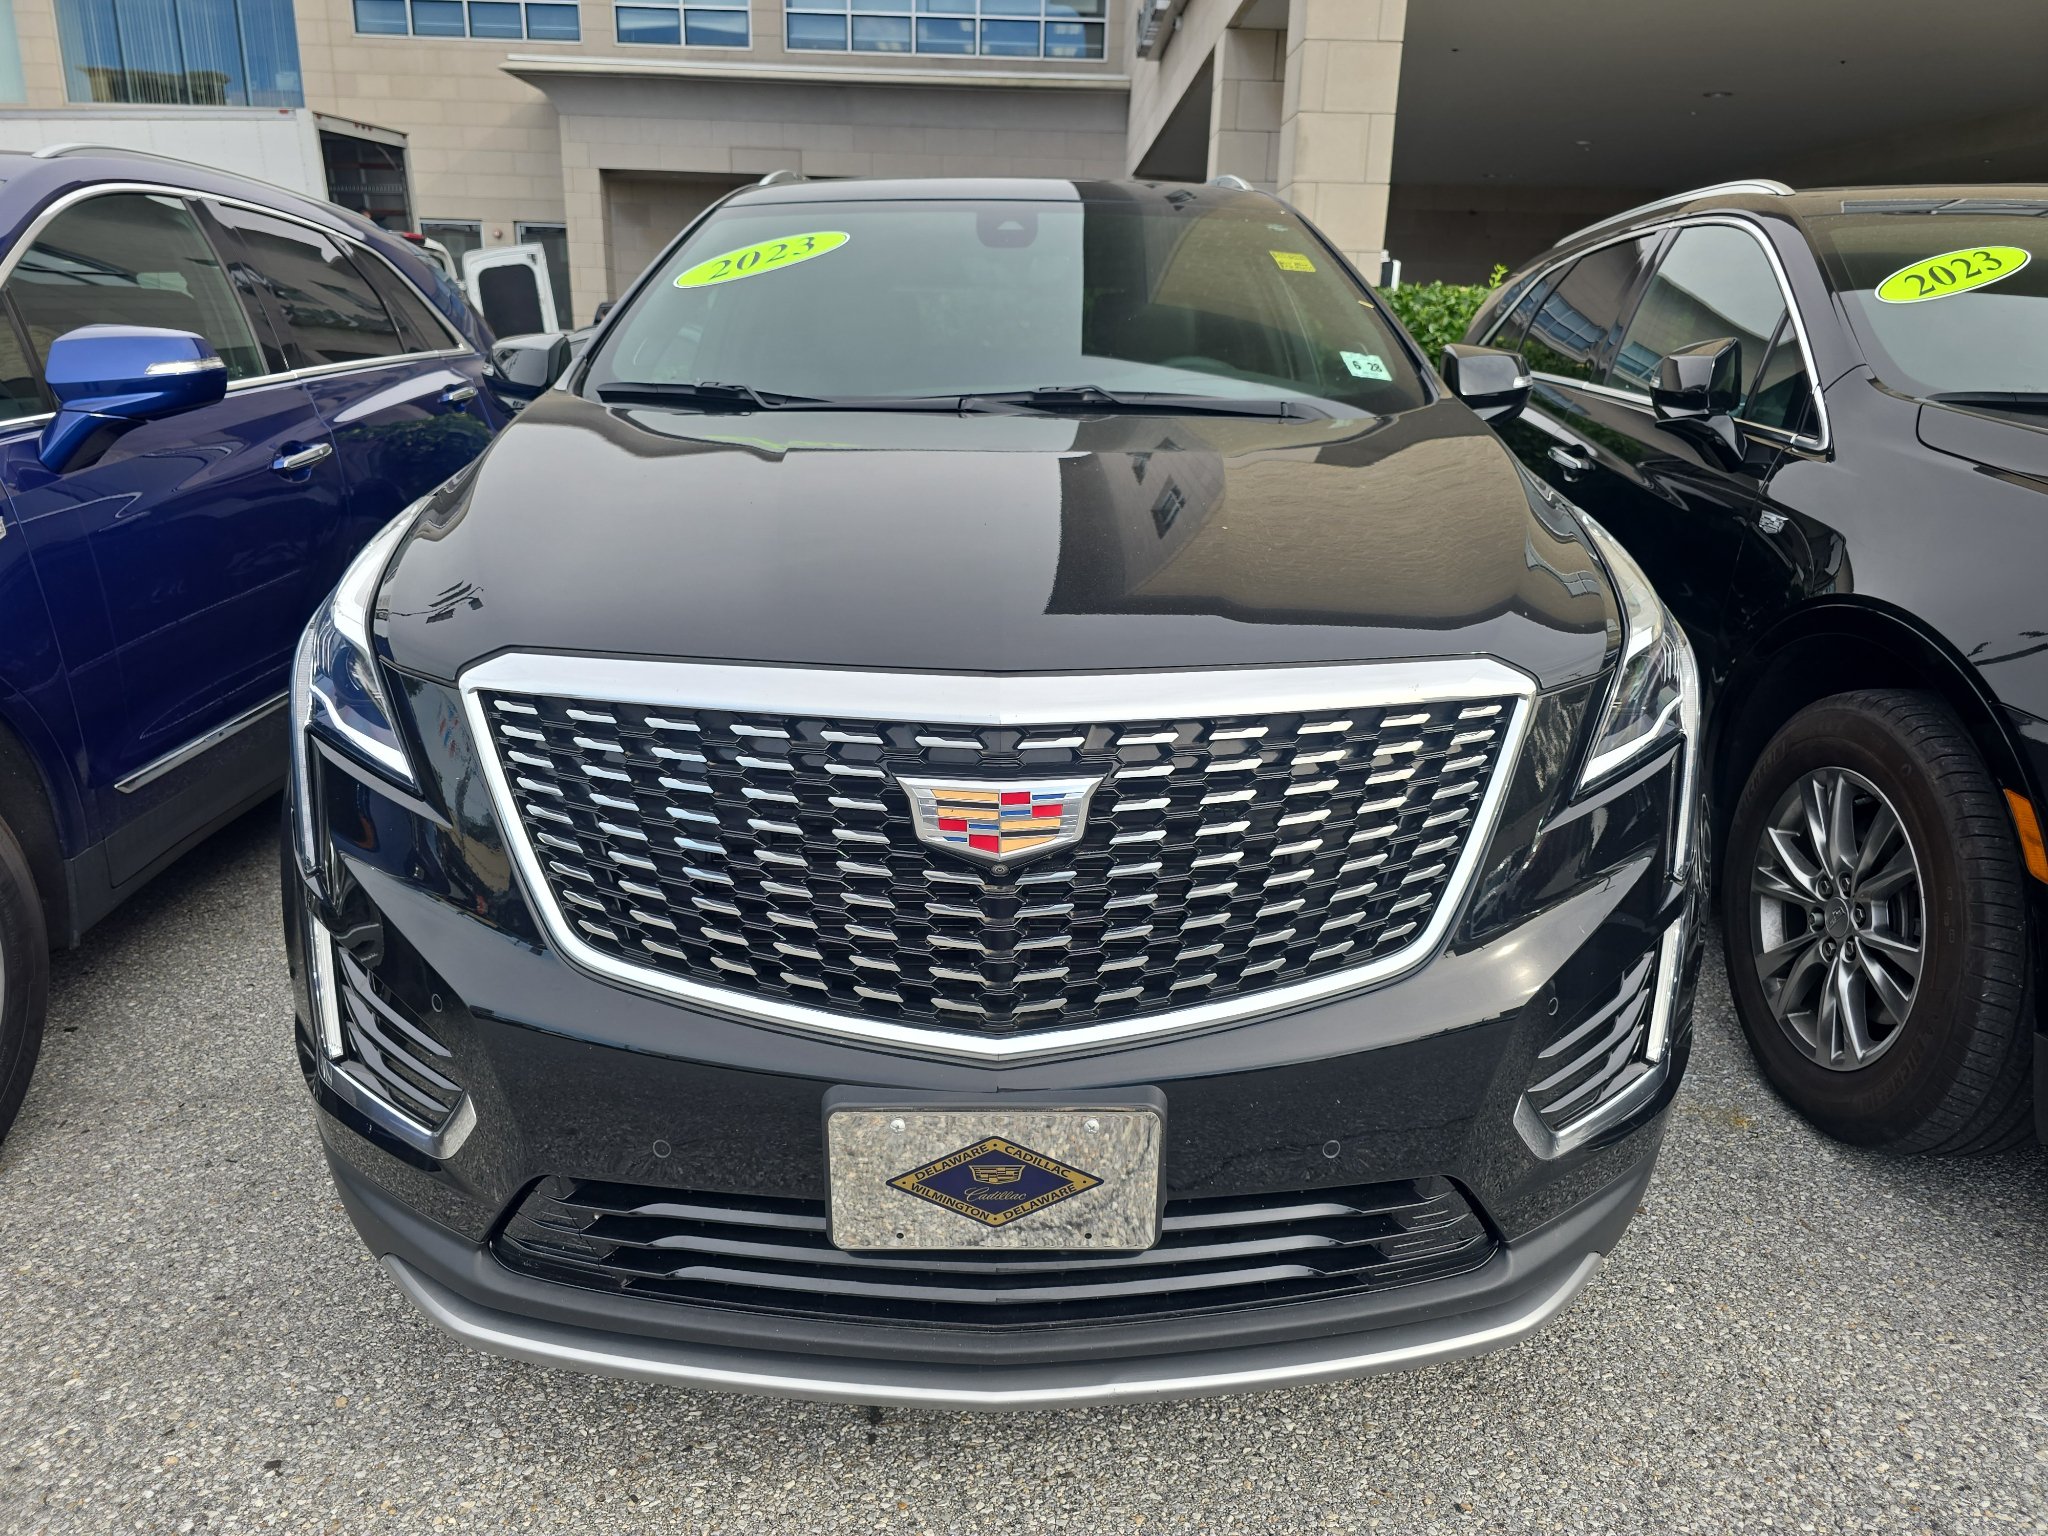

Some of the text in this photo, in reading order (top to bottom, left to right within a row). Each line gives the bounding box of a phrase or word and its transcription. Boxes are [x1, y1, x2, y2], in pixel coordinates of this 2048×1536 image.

[708, 236, 816, 281] 2023
[1904, 250, 2003, 297] 2023
[914, 1144, 1071, 1180] DELAWARE CADILLAC
[911, 1183, 1077, 1220] WILMINGTON DELAWARE
[964, 1187, 1027, 1202] Cadillac
